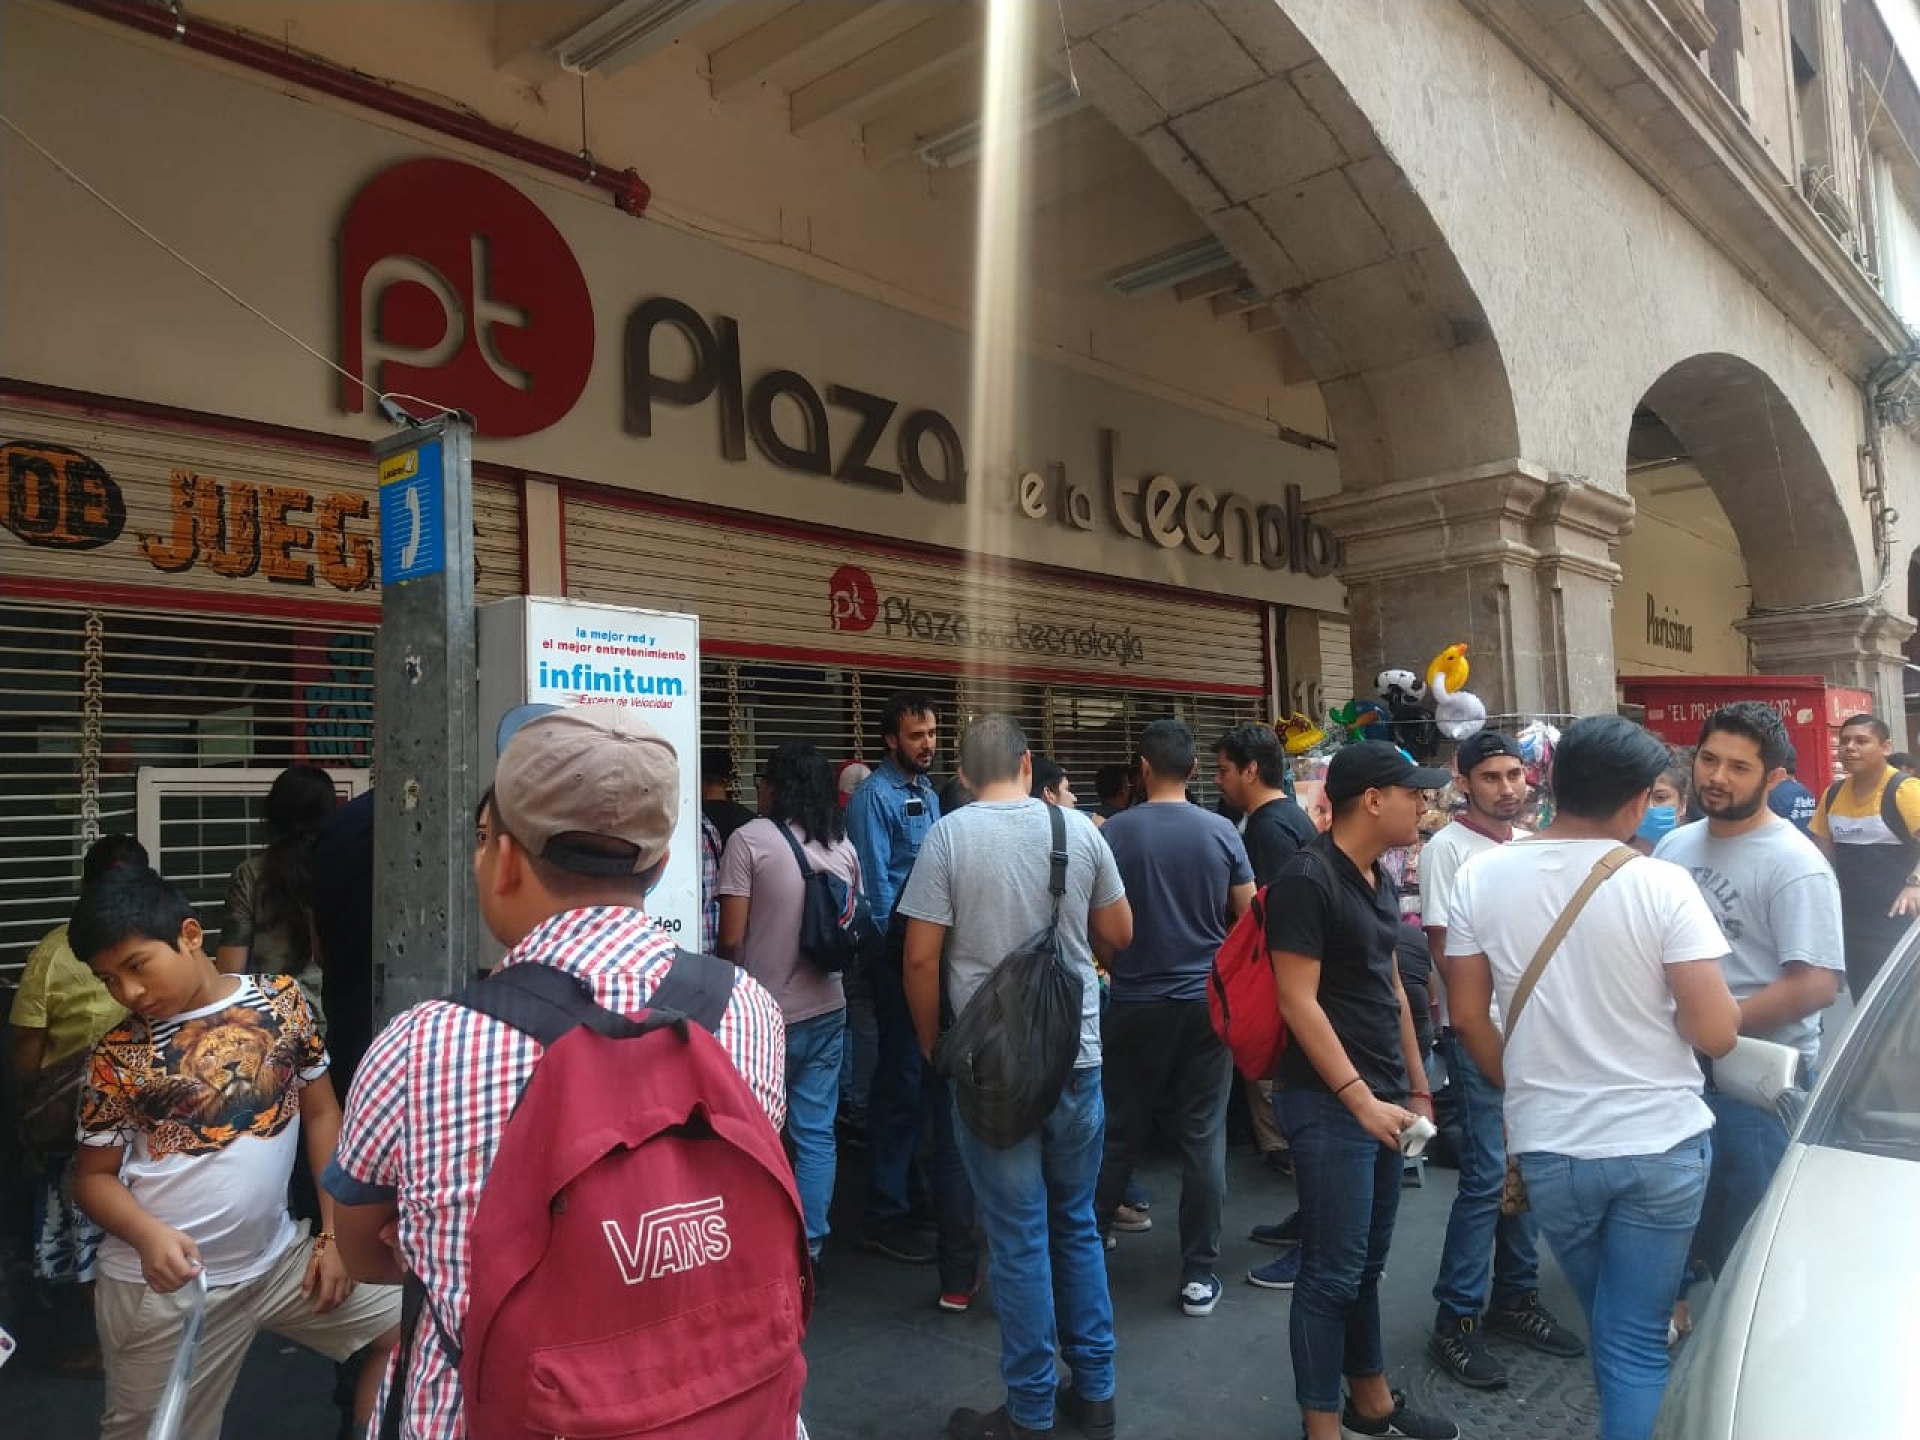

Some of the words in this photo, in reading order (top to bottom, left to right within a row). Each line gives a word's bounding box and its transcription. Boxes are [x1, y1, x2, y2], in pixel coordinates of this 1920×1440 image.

[621, 296, 968, 506] Plaza
[1050, 460, 1095, 532] la
[1097, 427, 1342, 579] tecnolo
[138, 468, 377, 593] JUEG
[542, 639, 553, 649] el
[557, 641, 592, 654] mejor
[595, 644, 687, 661] entretenimiento
[575, 626, 587, 638] la
[590, 629, 624, 642] mejor
[627, 633, 646, 643] red
[649, 637, 656, 646] y
[1646, 591, 1693, 653] Parisina
[539, 661, 683, 697] infinitum
[602, 1195, 731, 1285] VANS
